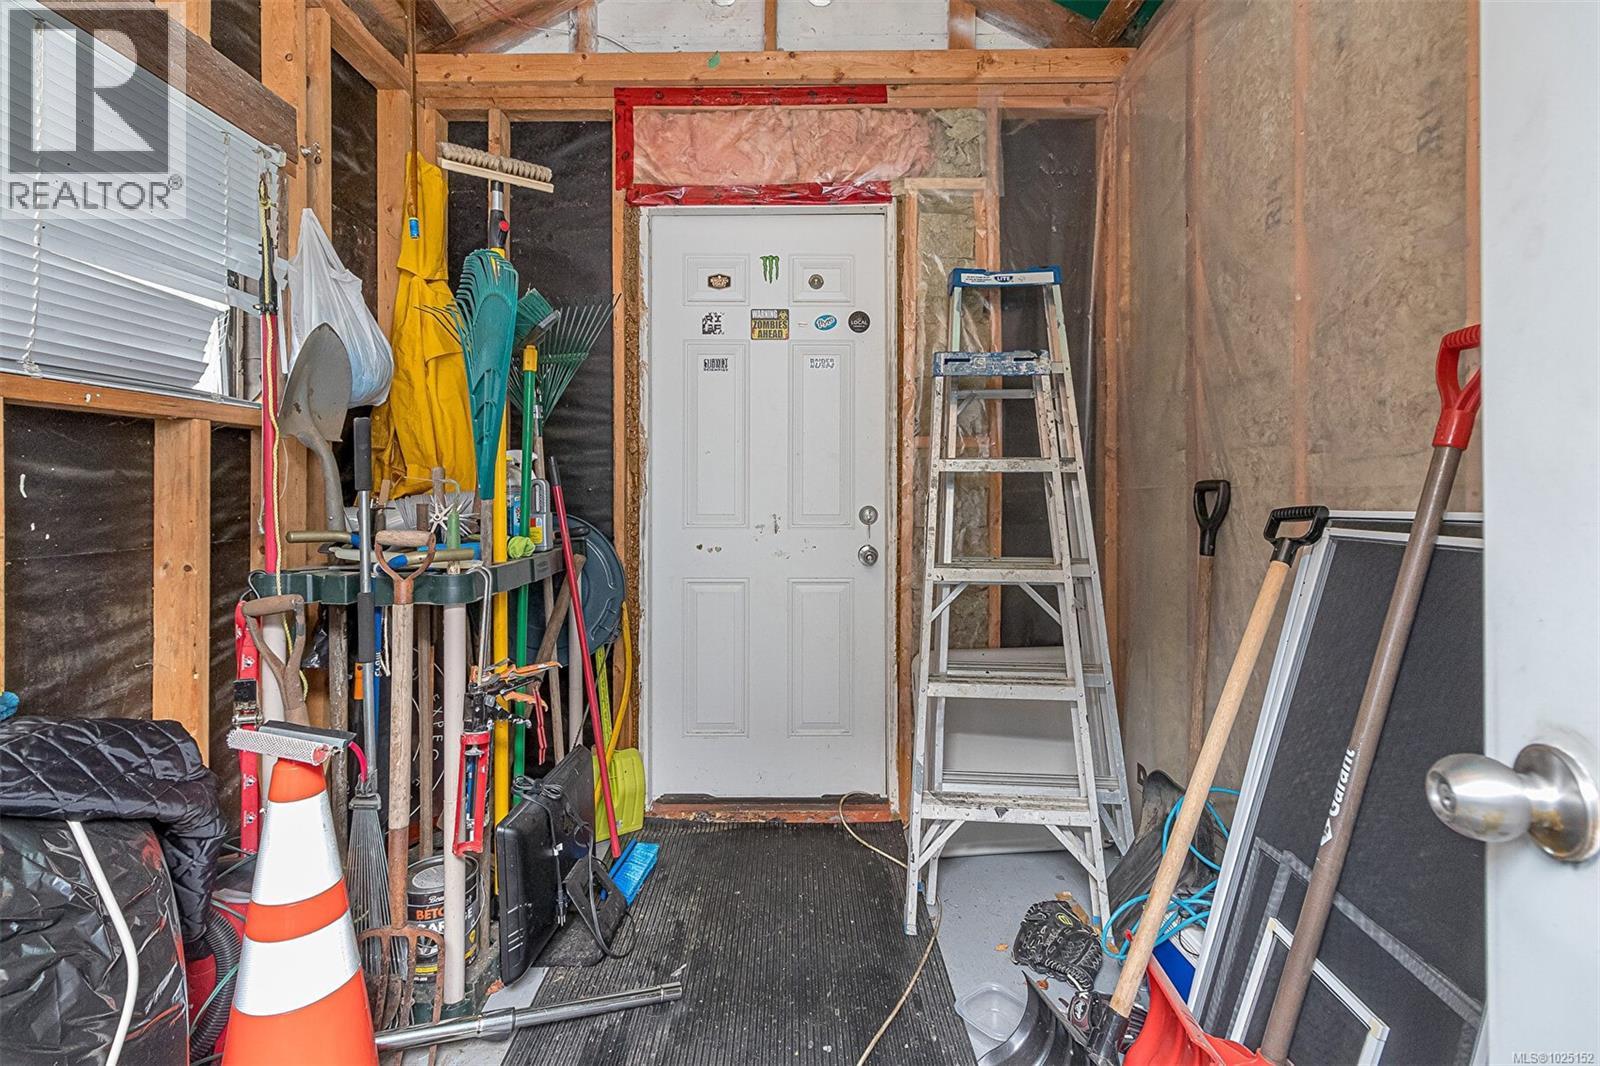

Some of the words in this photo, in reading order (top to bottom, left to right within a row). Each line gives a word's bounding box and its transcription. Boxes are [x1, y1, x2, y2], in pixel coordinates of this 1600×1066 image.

[751, 310, 777, 319] WARNING
[752, 320, 788, 330] ZOMBIES
[757, 330, 783, 339] AHEAD
